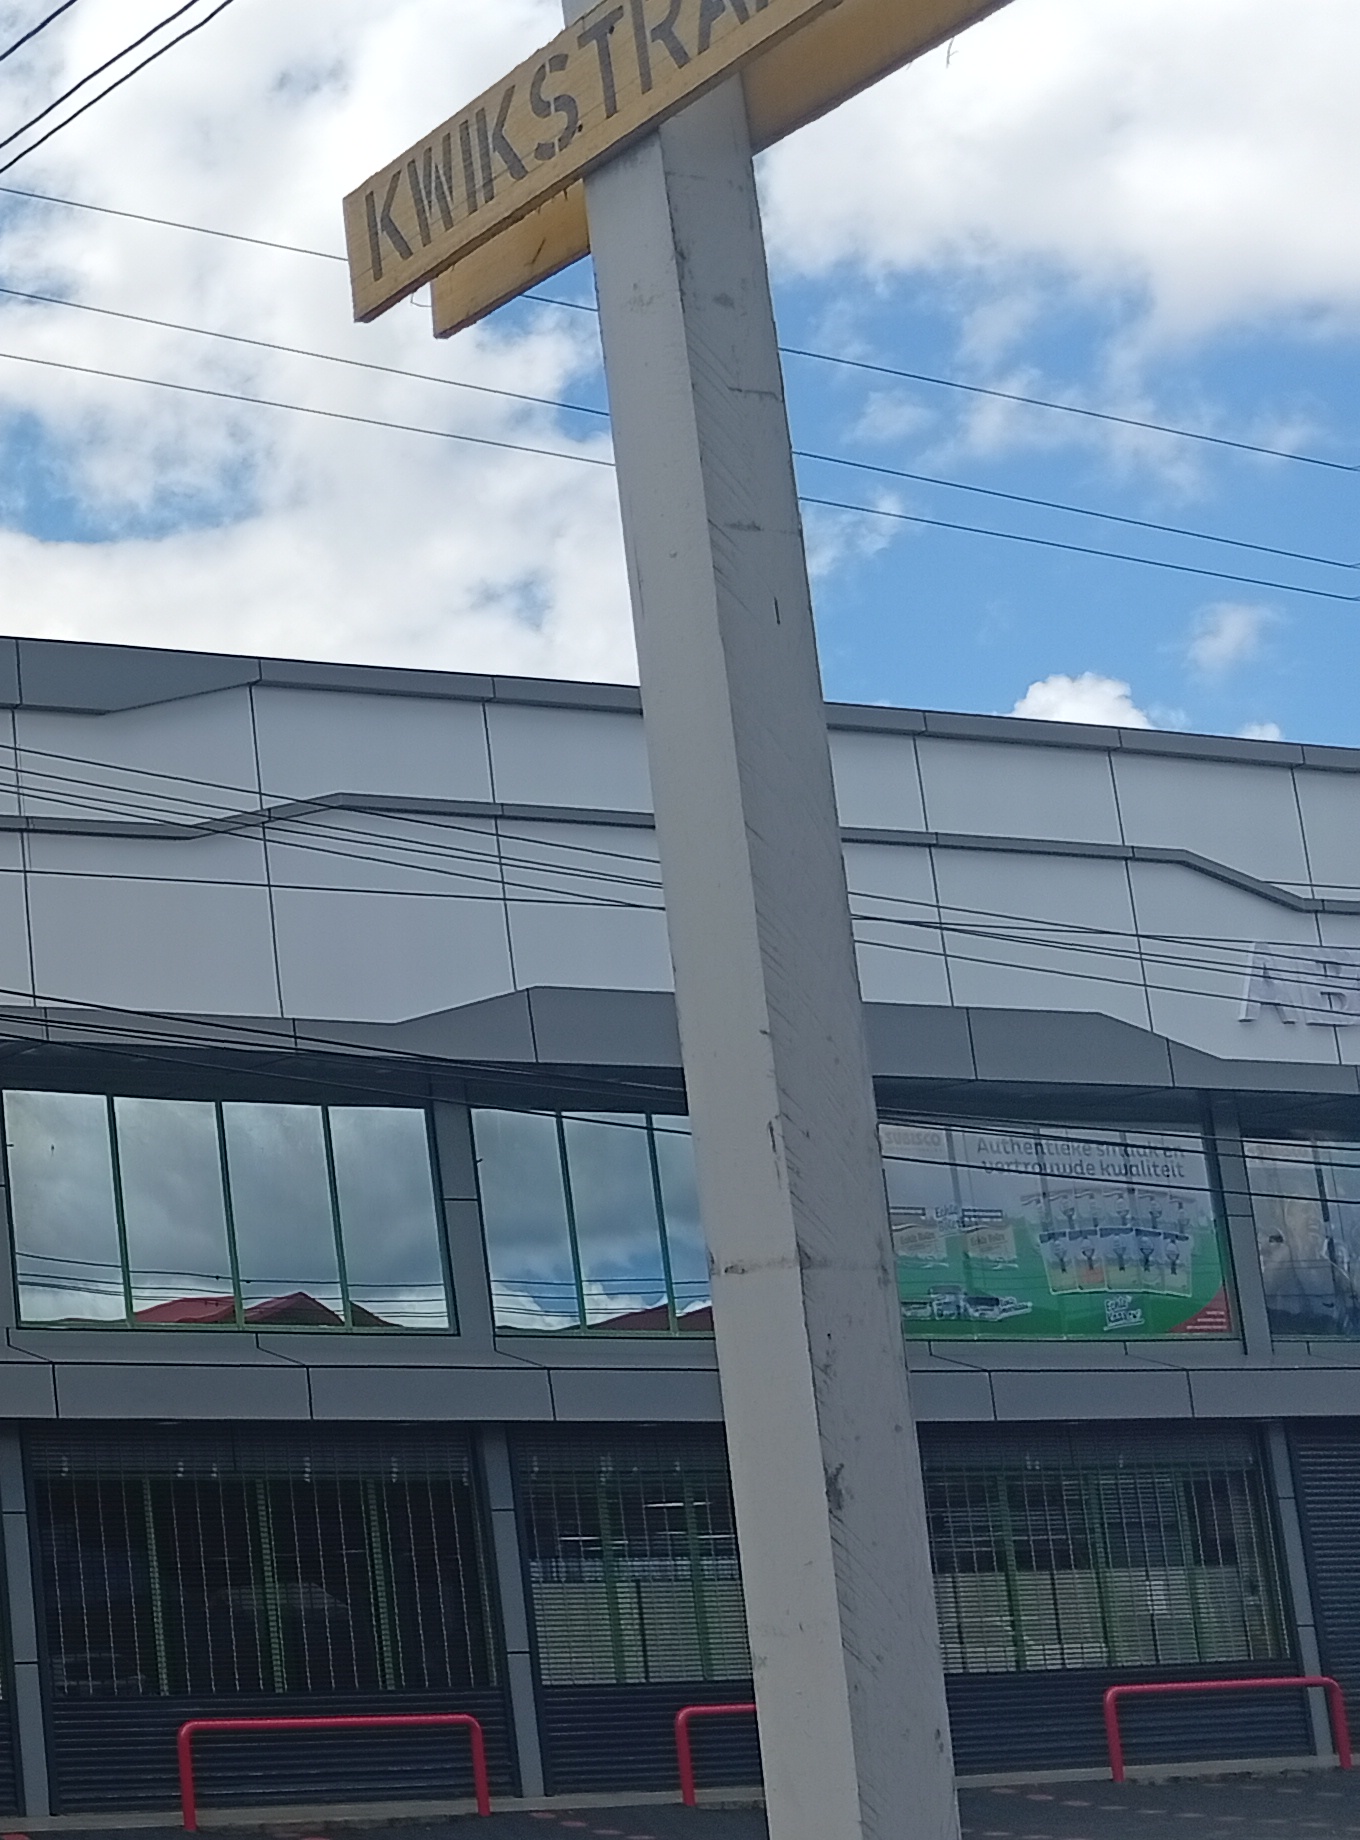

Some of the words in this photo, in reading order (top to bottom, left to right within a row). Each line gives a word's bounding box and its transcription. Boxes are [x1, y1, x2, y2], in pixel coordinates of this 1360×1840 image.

[365, 0, 768, 282] KWIKSTRA
[977, 1136, 1092, 1157] Authentieke
[1100, 1160, 1185, 1178] kwaliteit
